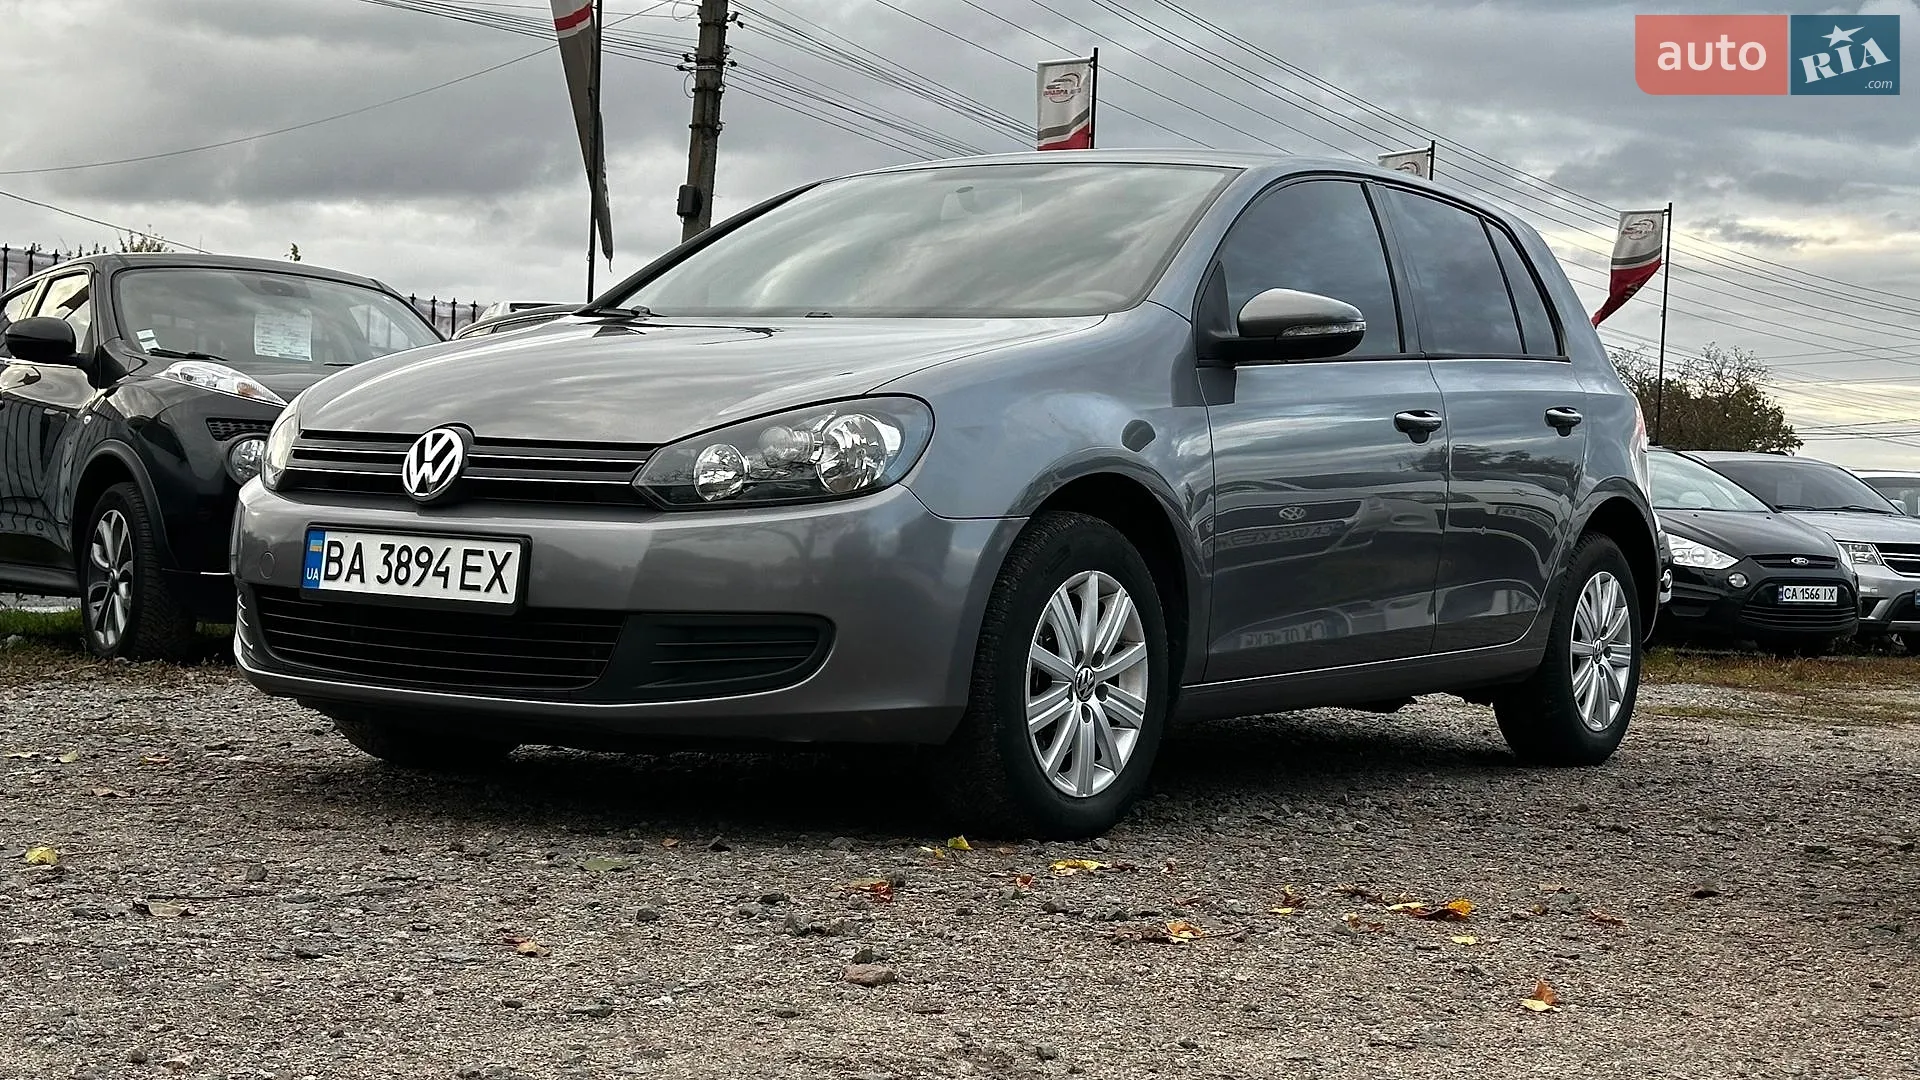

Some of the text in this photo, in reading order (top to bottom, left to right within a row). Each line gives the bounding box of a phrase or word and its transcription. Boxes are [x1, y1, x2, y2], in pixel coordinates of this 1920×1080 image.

[306, 567, 319, 580] UA
[323, 540, 513, 594] BA 3894 EX
[1784, 587, 1798, 600] CA
[1800, 587, 1820, 600] 1566
[1823, 588, 1835, 600] IX
